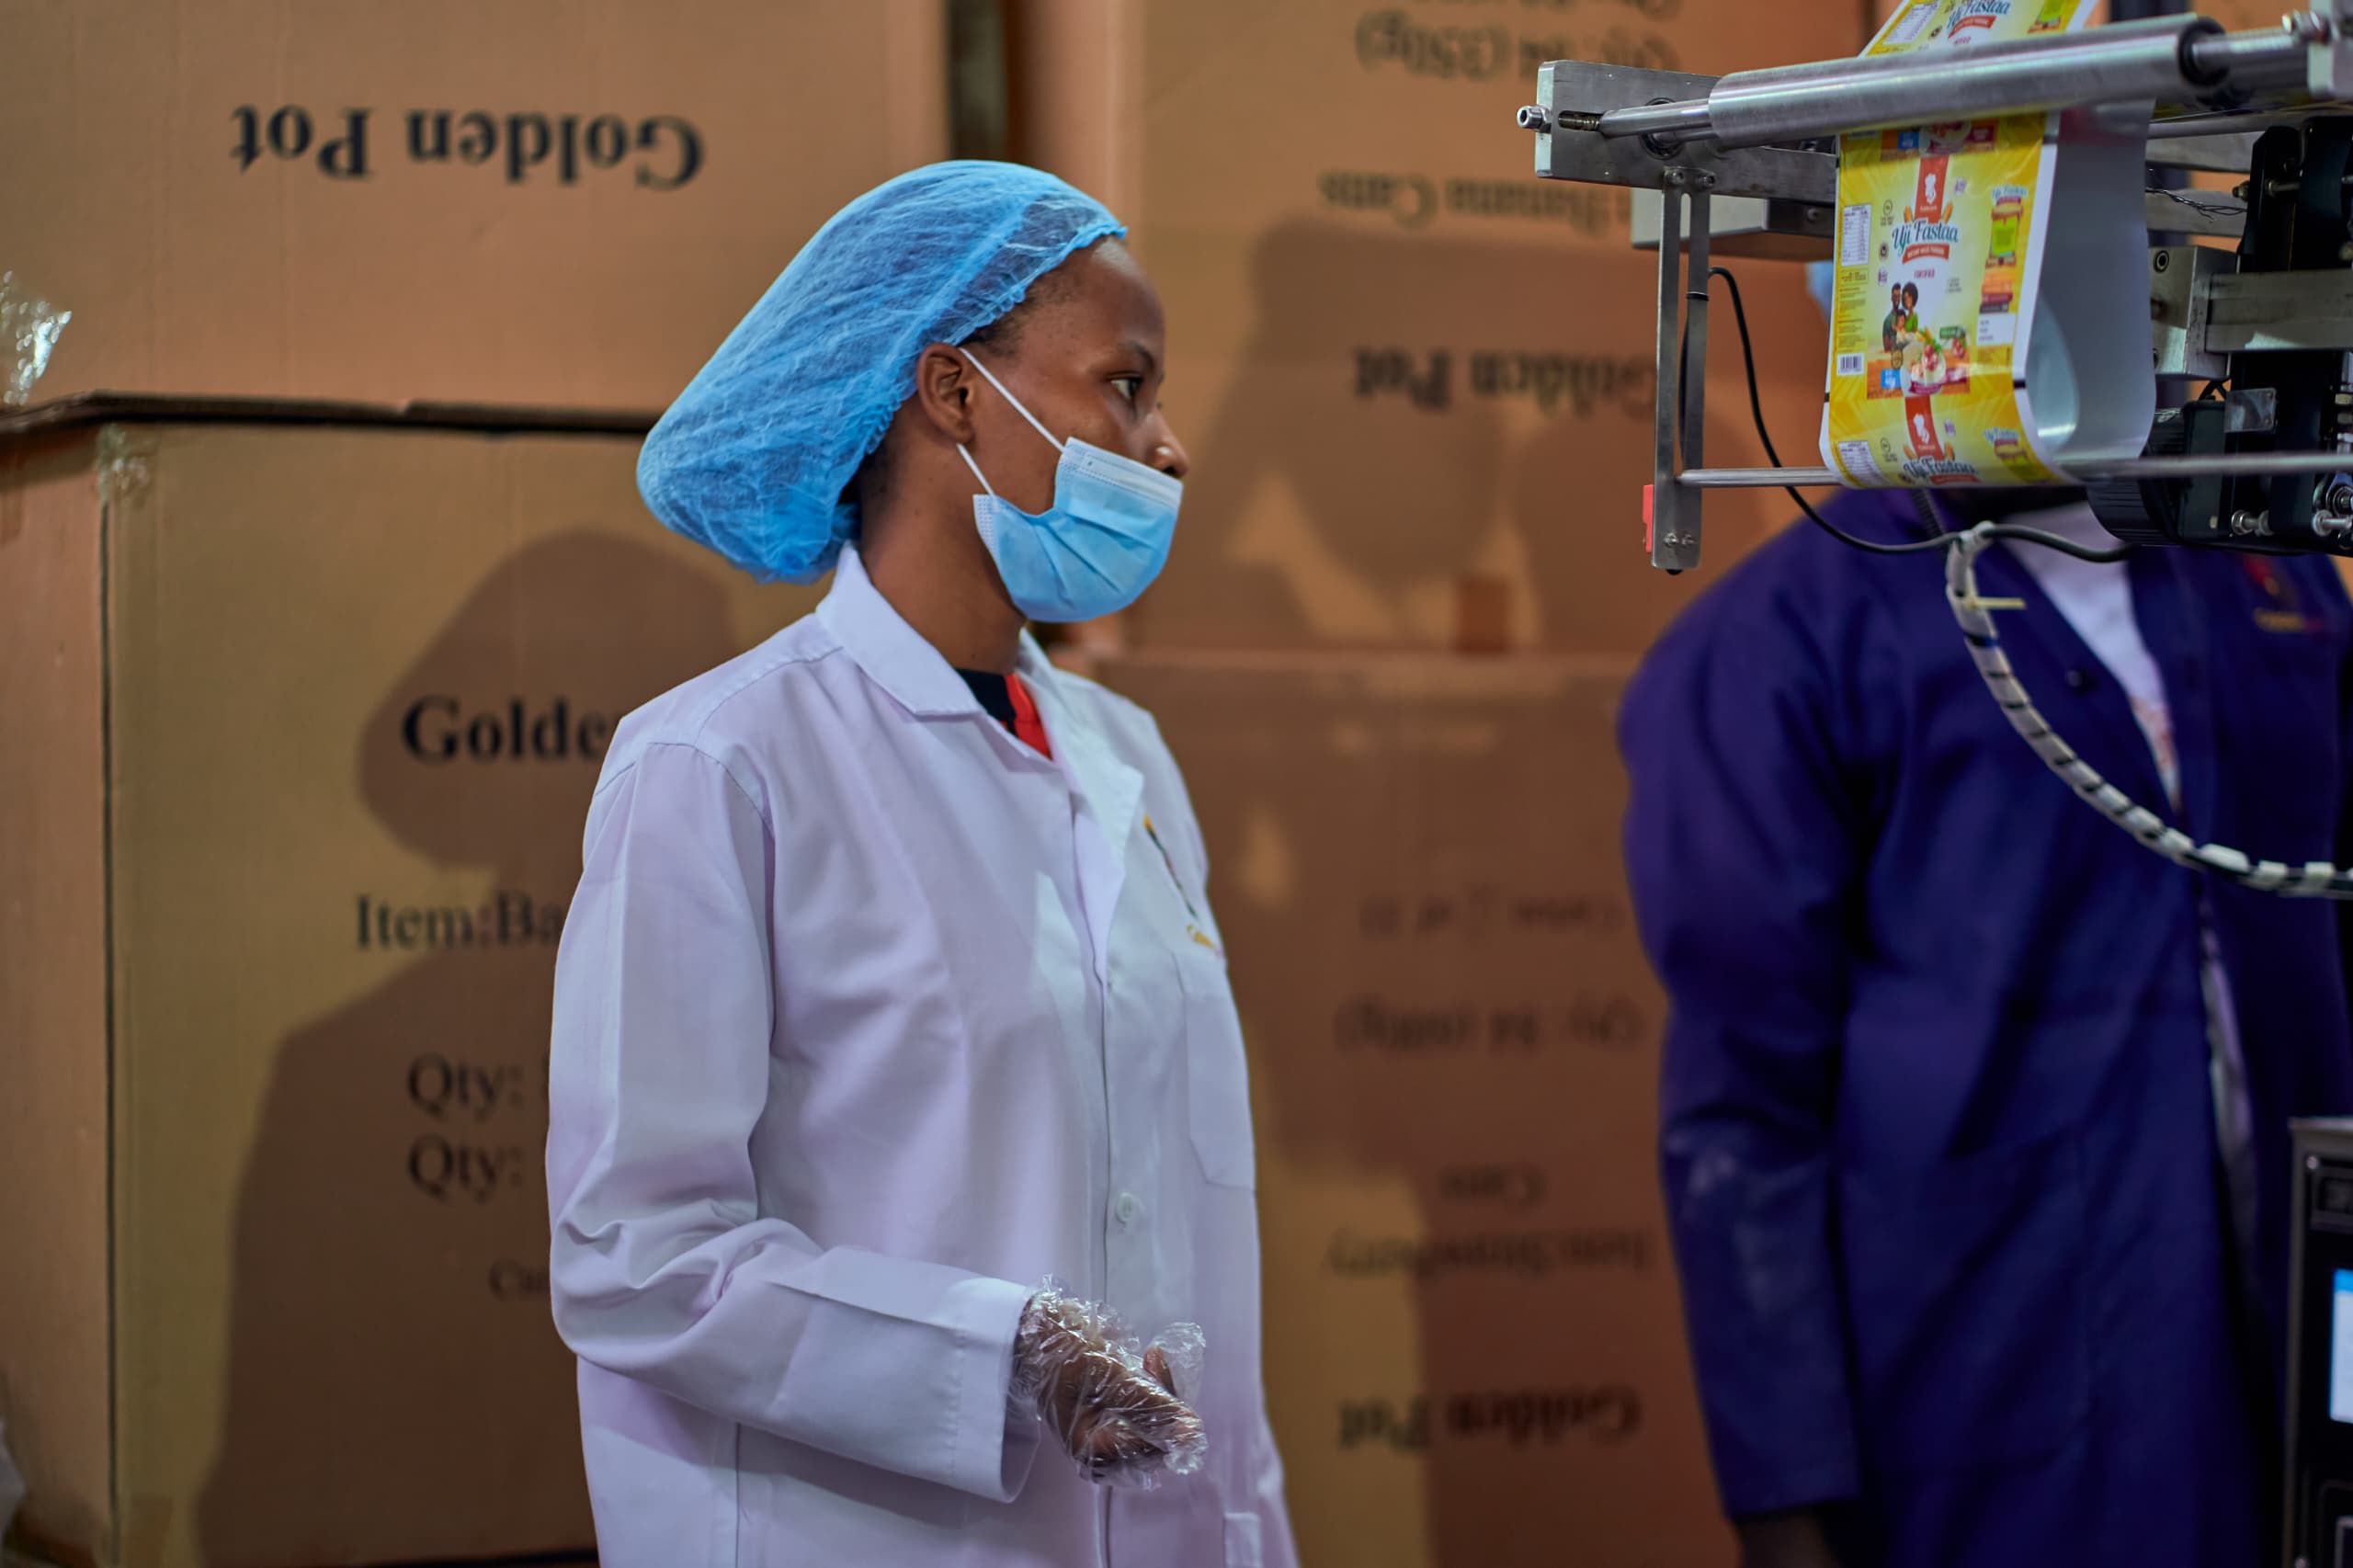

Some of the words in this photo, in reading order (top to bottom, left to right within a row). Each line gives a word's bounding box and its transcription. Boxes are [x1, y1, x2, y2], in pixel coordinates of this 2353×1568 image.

[229, 105, 373, 181] Pot
[406, 111, 705, 192] Golden
[1913, 220, 1959, 243] Fastaa
[401, 695, 618, 765] Golde
[355, 892, 564, 951] Item:Ba
[407, 1052, 525, 1123] Qty:
[407, 1134, 525, 1206] Qty:
